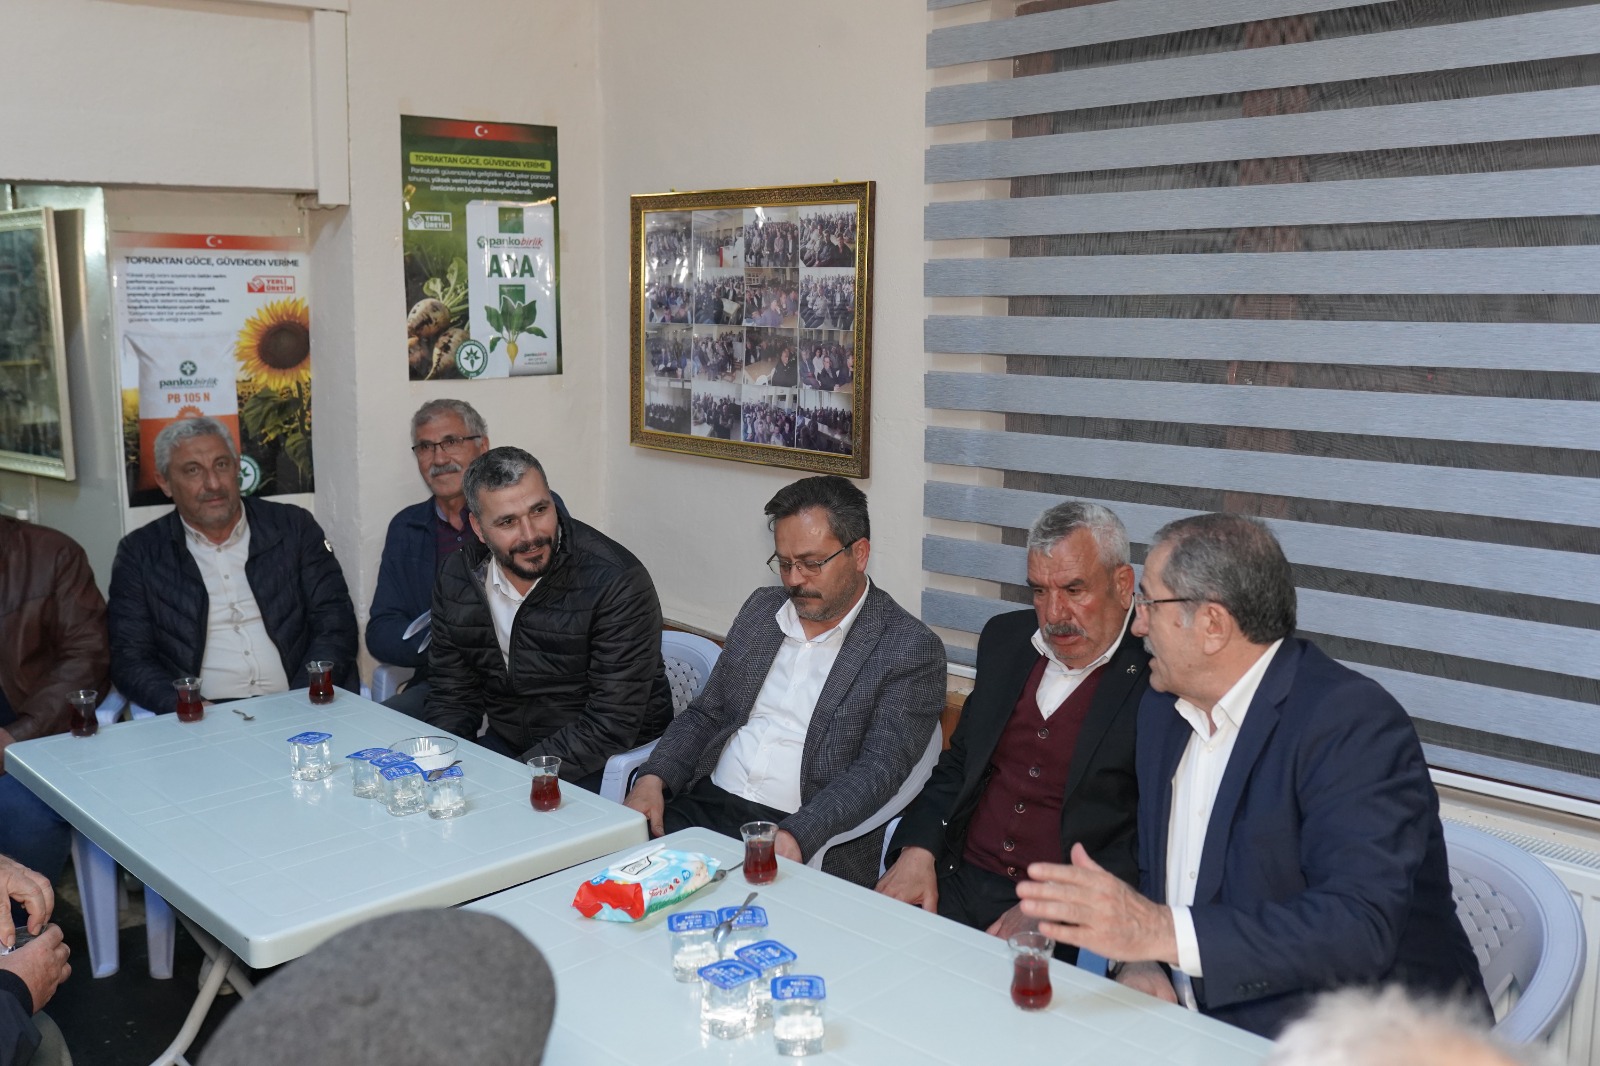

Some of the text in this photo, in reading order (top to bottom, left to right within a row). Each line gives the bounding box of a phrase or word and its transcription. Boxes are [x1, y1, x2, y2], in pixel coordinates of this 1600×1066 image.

[415, 154, 547, 169] TOPRAKTAN GÜCE, GÜVENDEN VERİME
[125, 256, 299, 267] TOPRAKTAN GÜCE, GÜVENDEN VERİME
[167, 392, 210, 404] PB 105 N
